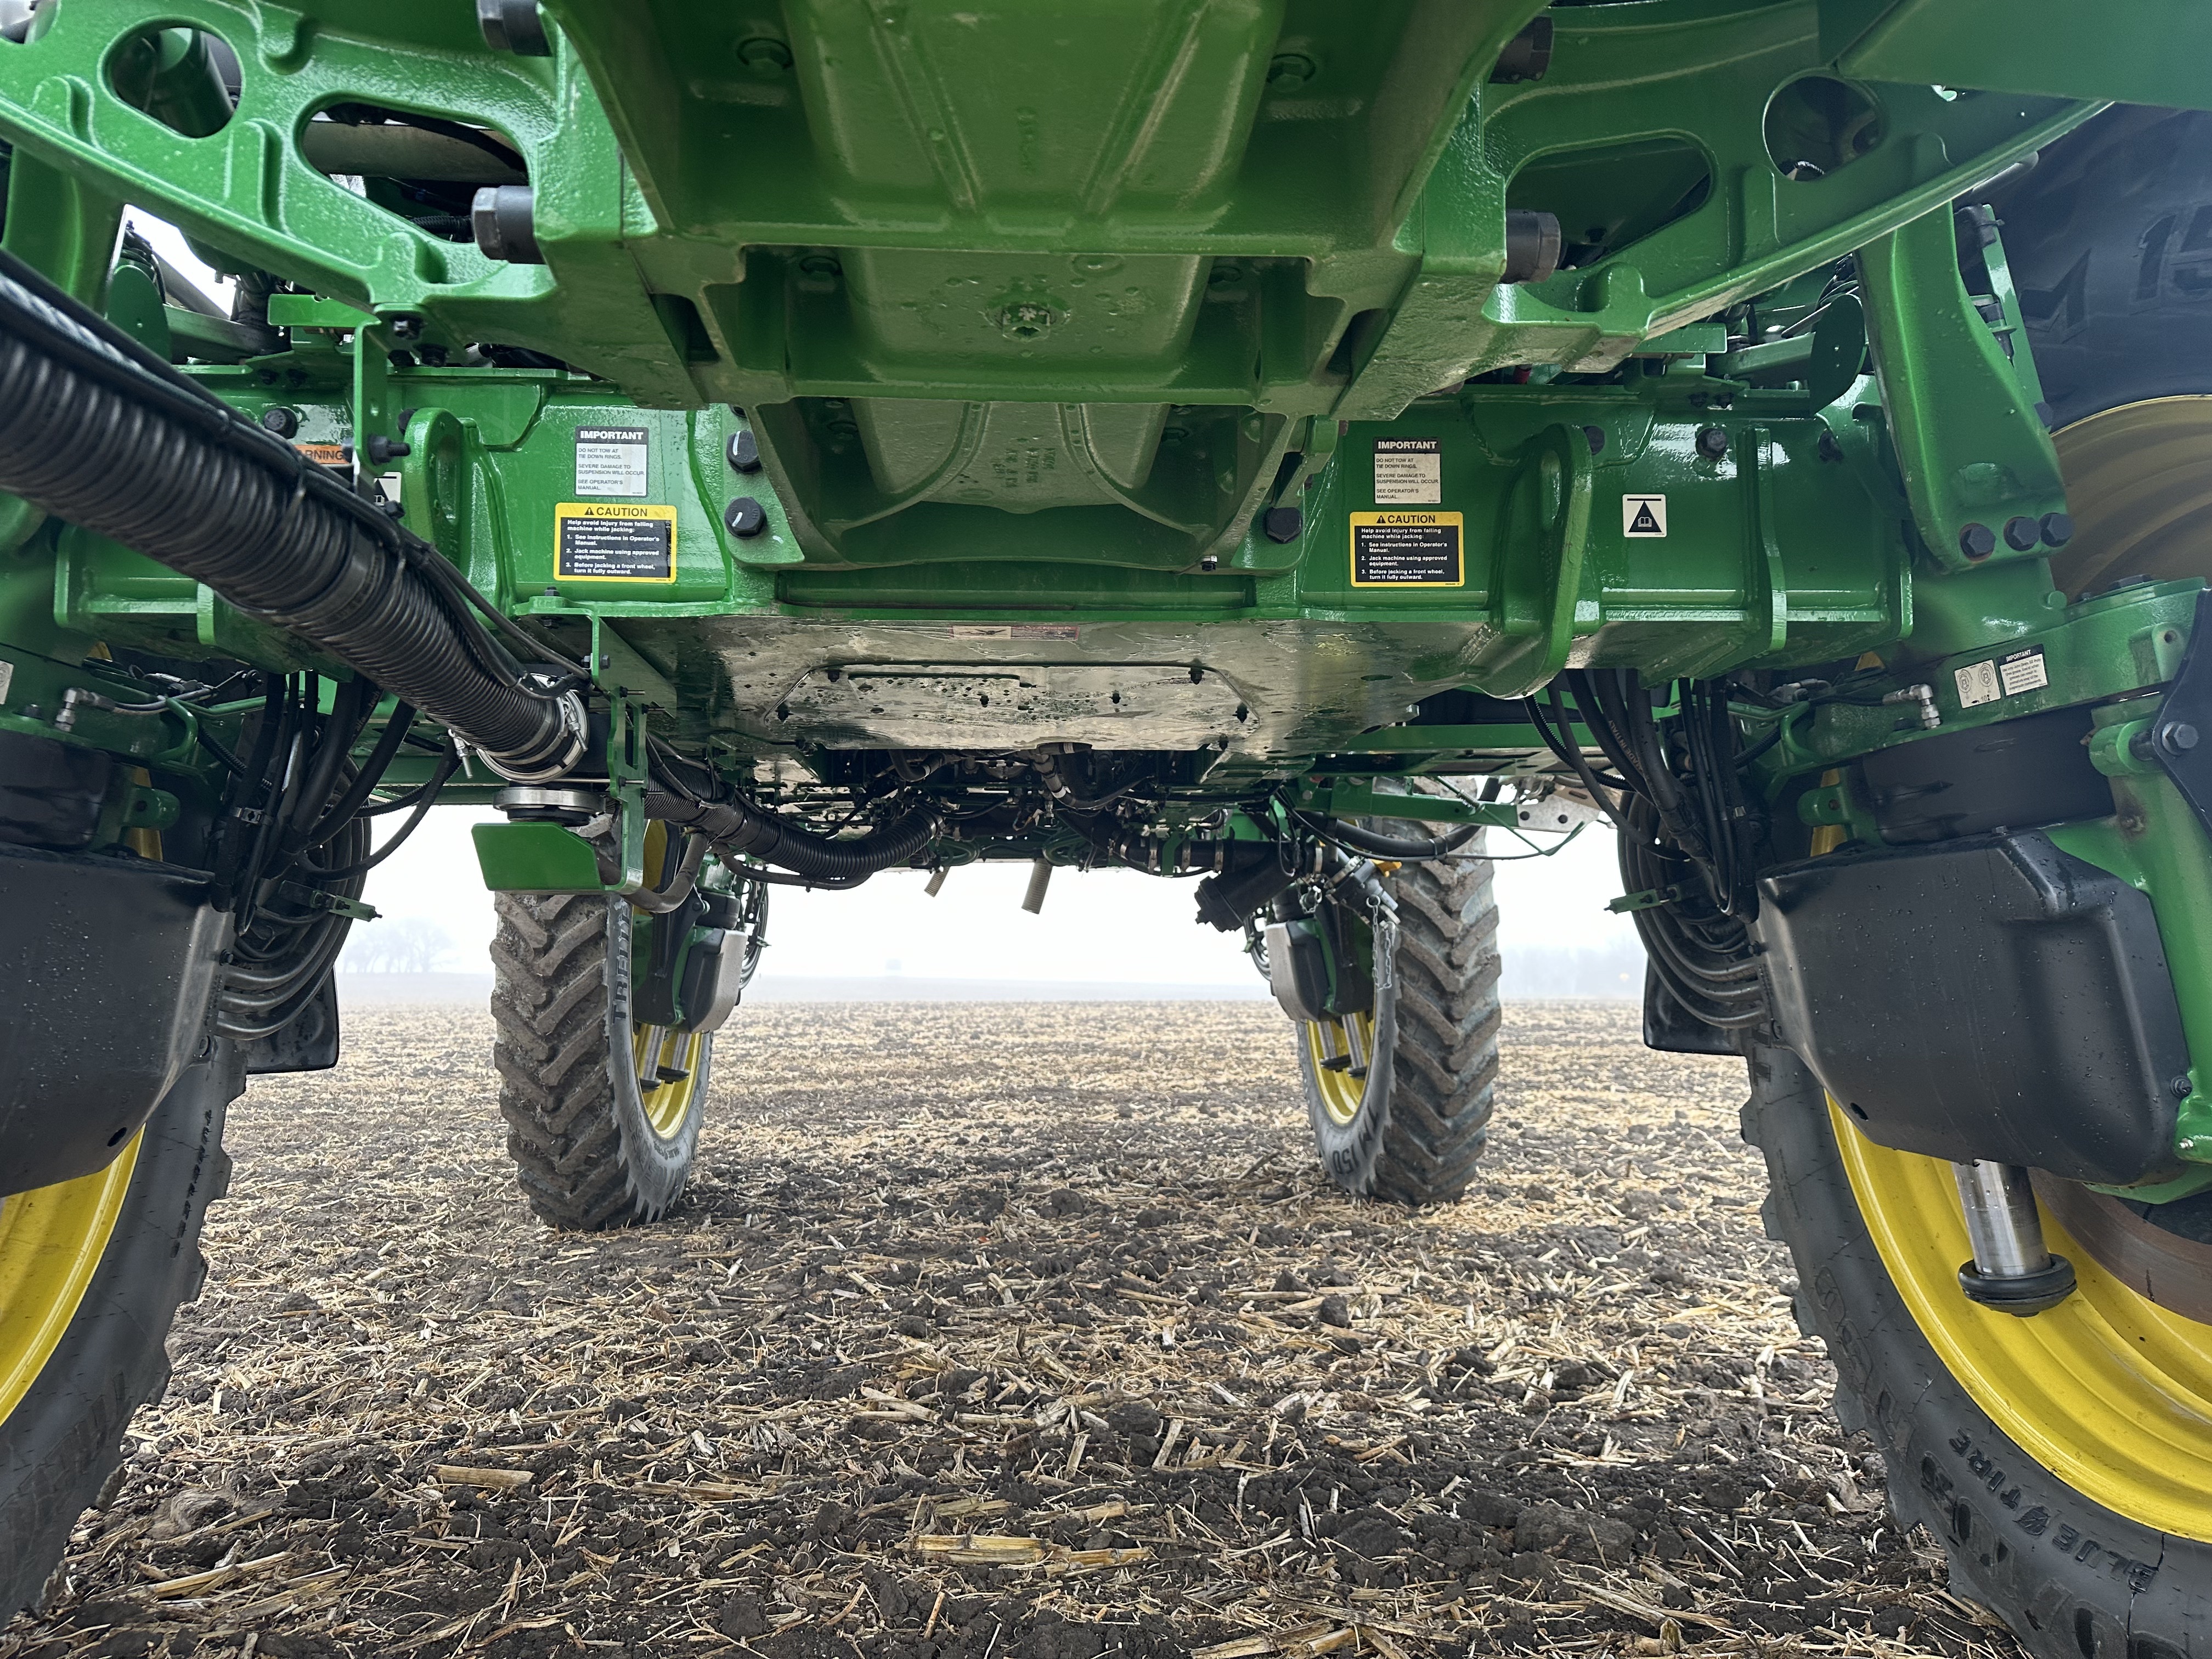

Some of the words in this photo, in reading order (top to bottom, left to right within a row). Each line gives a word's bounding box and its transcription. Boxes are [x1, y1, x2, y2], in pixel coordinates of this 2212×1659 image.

[580, 430, 644, 440] IMPORTANT
[1378, 441, 1437, 449] IMPORTANT
[596, 507, 648, 517] CAUTION
[1387, 515, 1436, 523] CAUTION
[2006, 650, 2031, 662] IMPORTANT
[1608, 720, 1623, 740] ITALY
[611, 898, 630, 1025] TRELLE
[1332, 1143, 1359, 1175] 150
[1948, 1426, 2023, 1511] TIRE
[2051, 1521, 2159, 1594] BLUE
